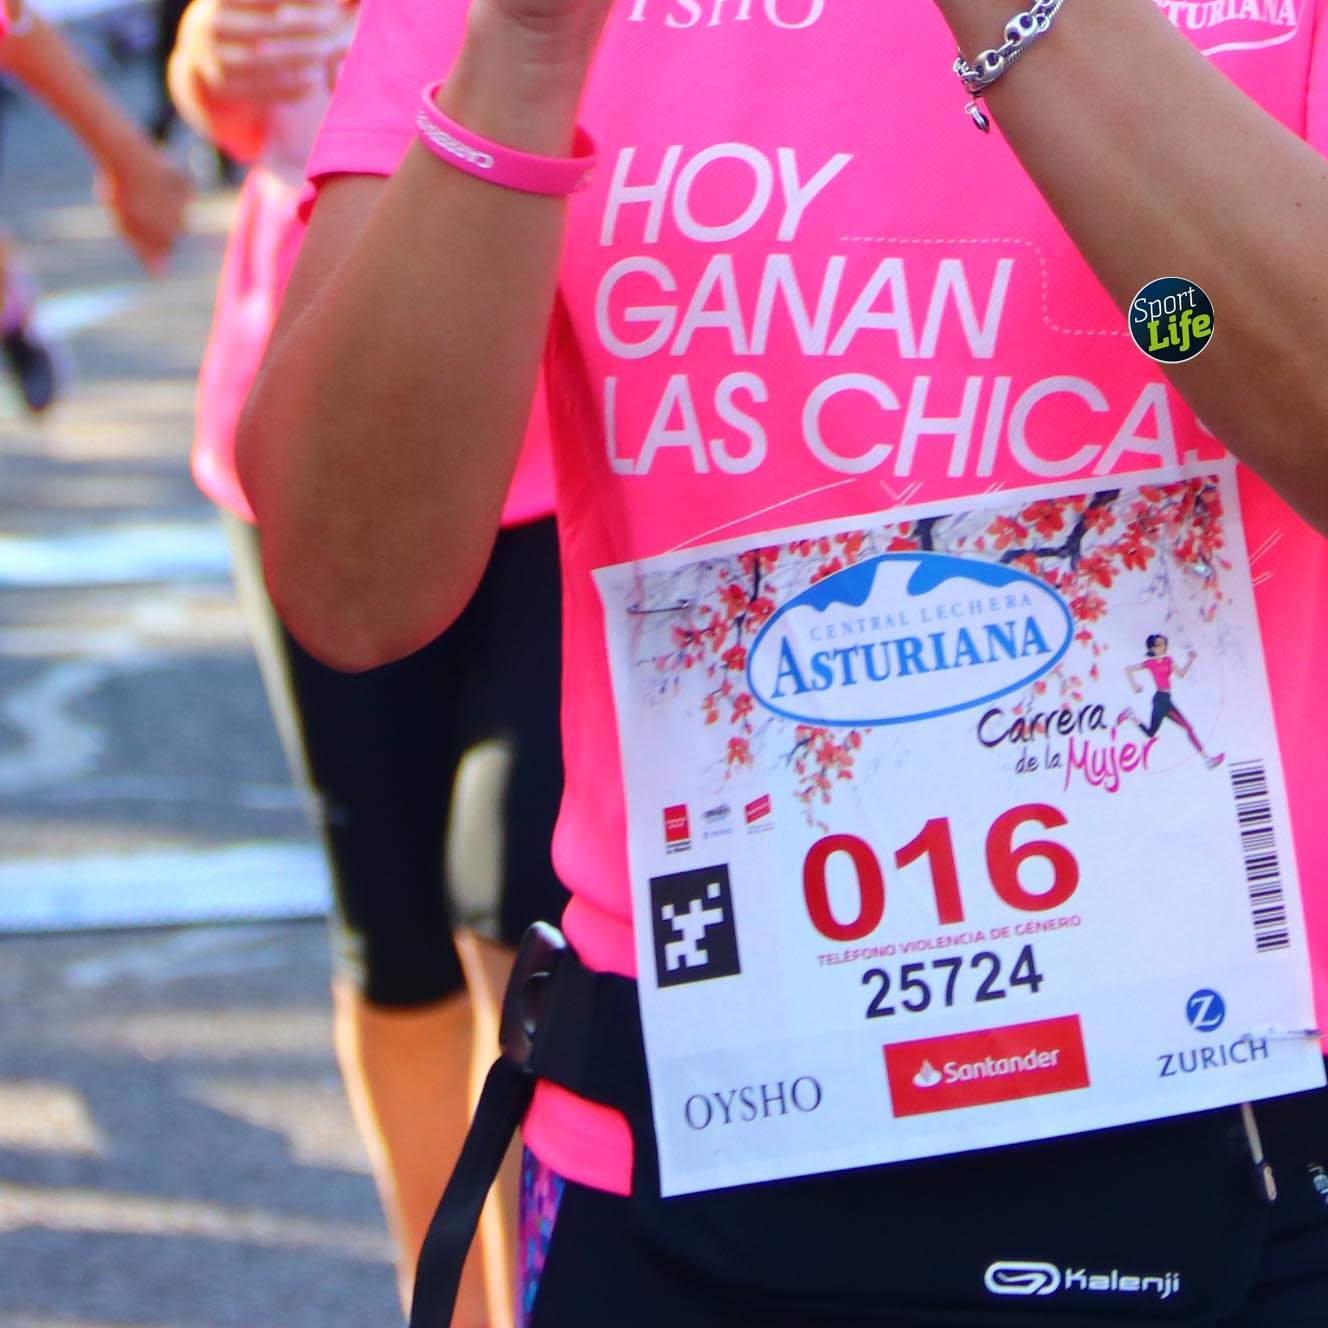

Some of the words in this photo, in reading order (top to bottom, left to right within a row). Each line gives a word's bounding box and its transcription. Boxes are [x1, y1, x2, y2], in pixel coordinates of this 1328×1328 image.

[599, 141, 854, 247] HOY
[595, 252, 1015, 360] GANAN
[604, 370, 770, 476] LAS
[801, 372, 1234, 479] CHICA
[809, 610, 911, 642] CENTRAL
[919, 593, 1033, 624] LECHERA
[769, 614, 1052, 700] ASTURIANA
[977, 704, 1108, 748] Carrera
[1015, 745, 1040, 774] de
[1045, 743, 1062, 770] la
[1063, 726, 1159, 793] Mujer
[801, 801, 1081, 943] 016
[899, 929, 987, 956] VIOLENCIA
[989, 926, 1012, 942] DE
[860, 943, 1044, 1020] 25724
[943, 1046, 1062, 1085] Santander
[1157, 1036, 1269, 1078] ZURICH
[683, 1074, 824, 1131] OYSHO
[1064, 1267, 1180, 1300] Kalenji
